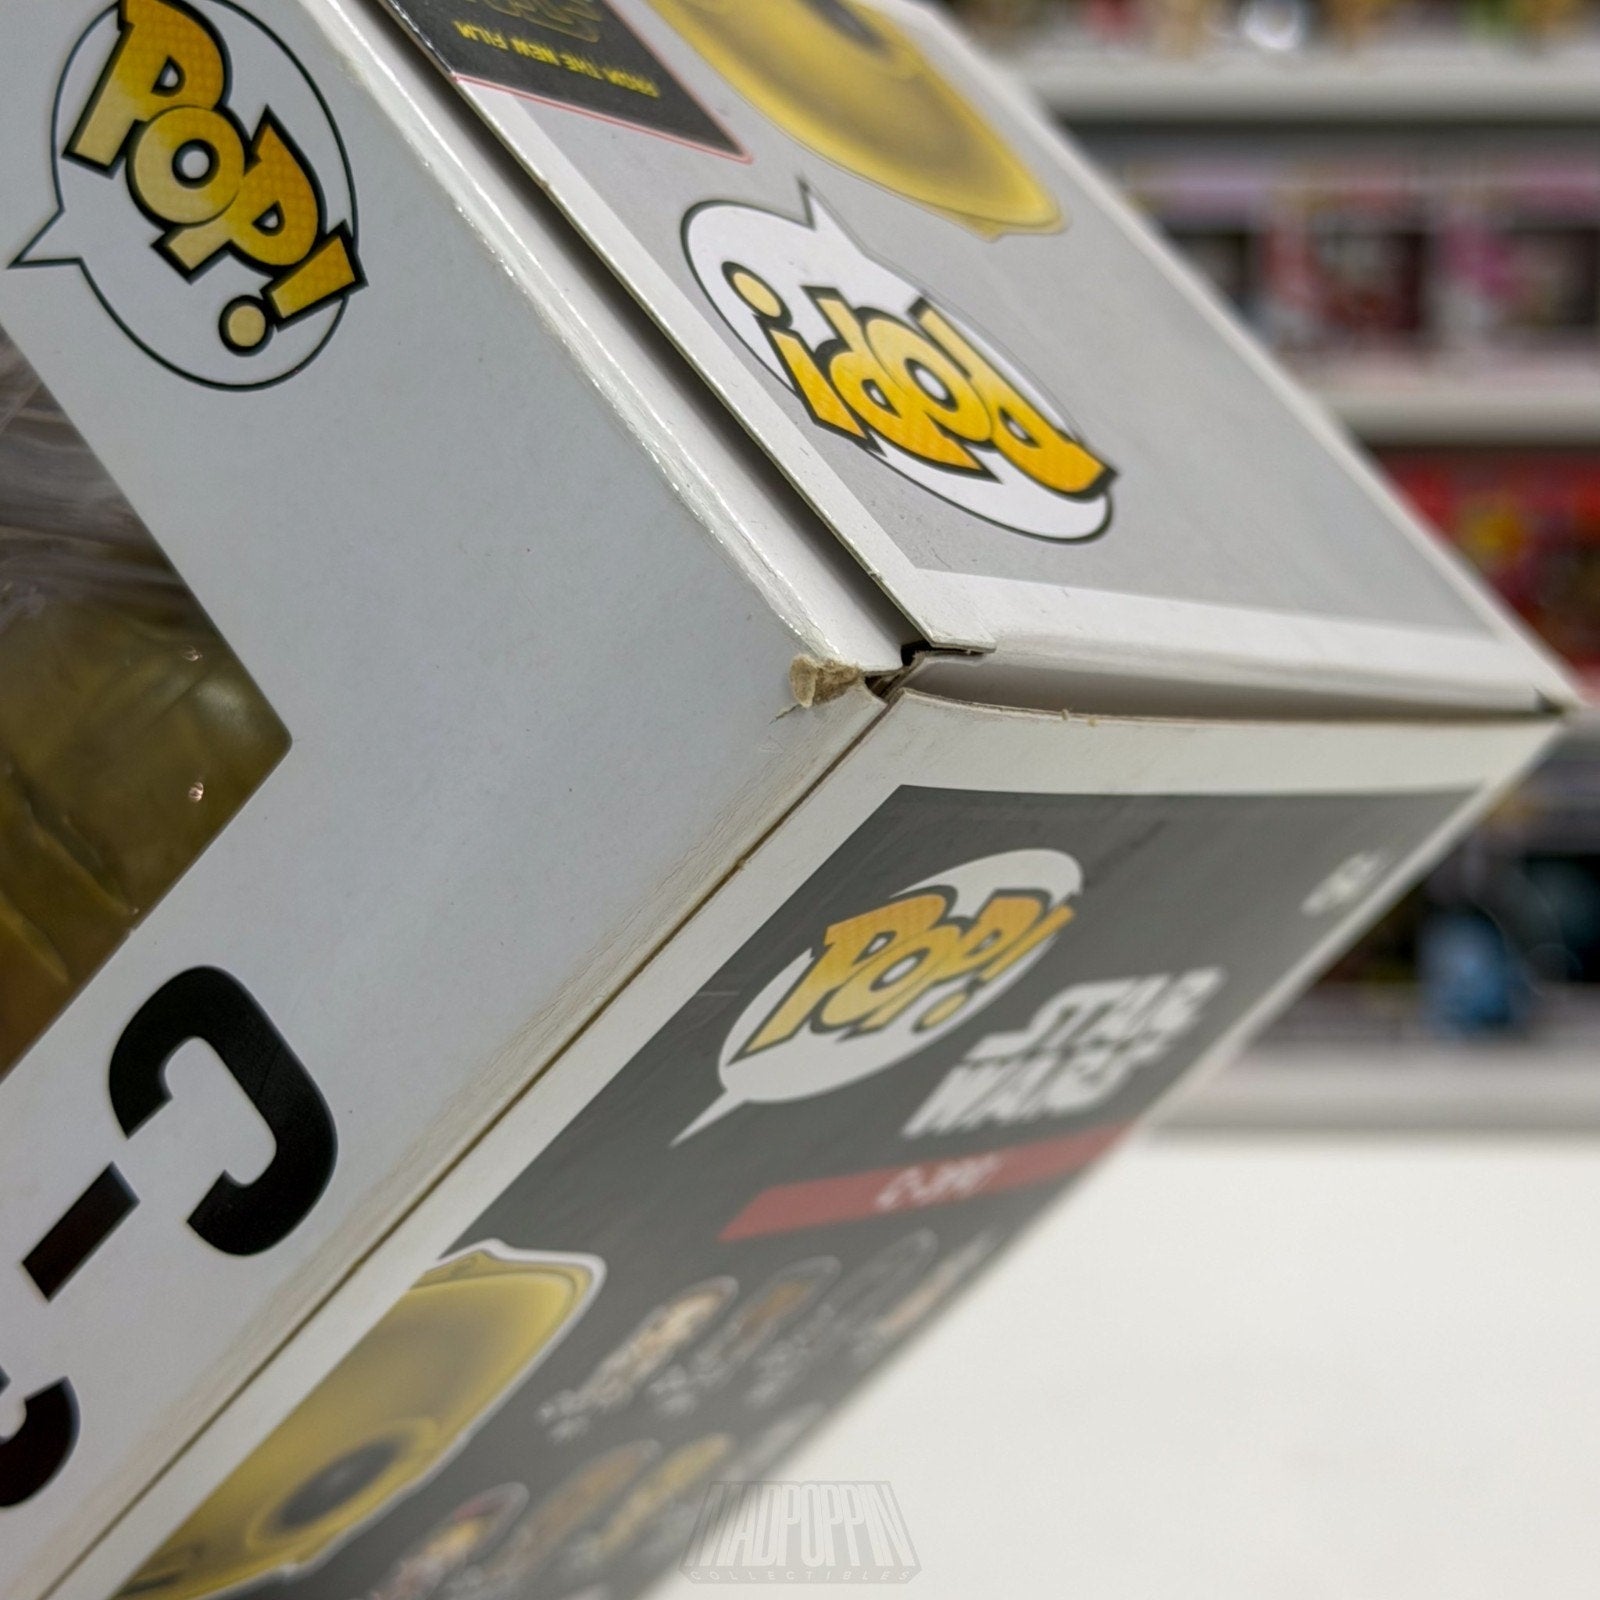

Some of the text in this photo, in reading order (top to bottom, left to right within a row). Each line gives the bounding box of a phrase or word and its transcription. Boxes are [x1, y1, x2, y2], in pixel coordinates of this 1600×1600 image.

[454, 21, 509, 49] FILM
[509, 37, 562, 65] NEW
[560, 53, 603, 79] THE
[62, 0, 368, 356] POP!
[721, 261, 1118, 503] POP!
[726, 884, 1080, 1066] POP!
